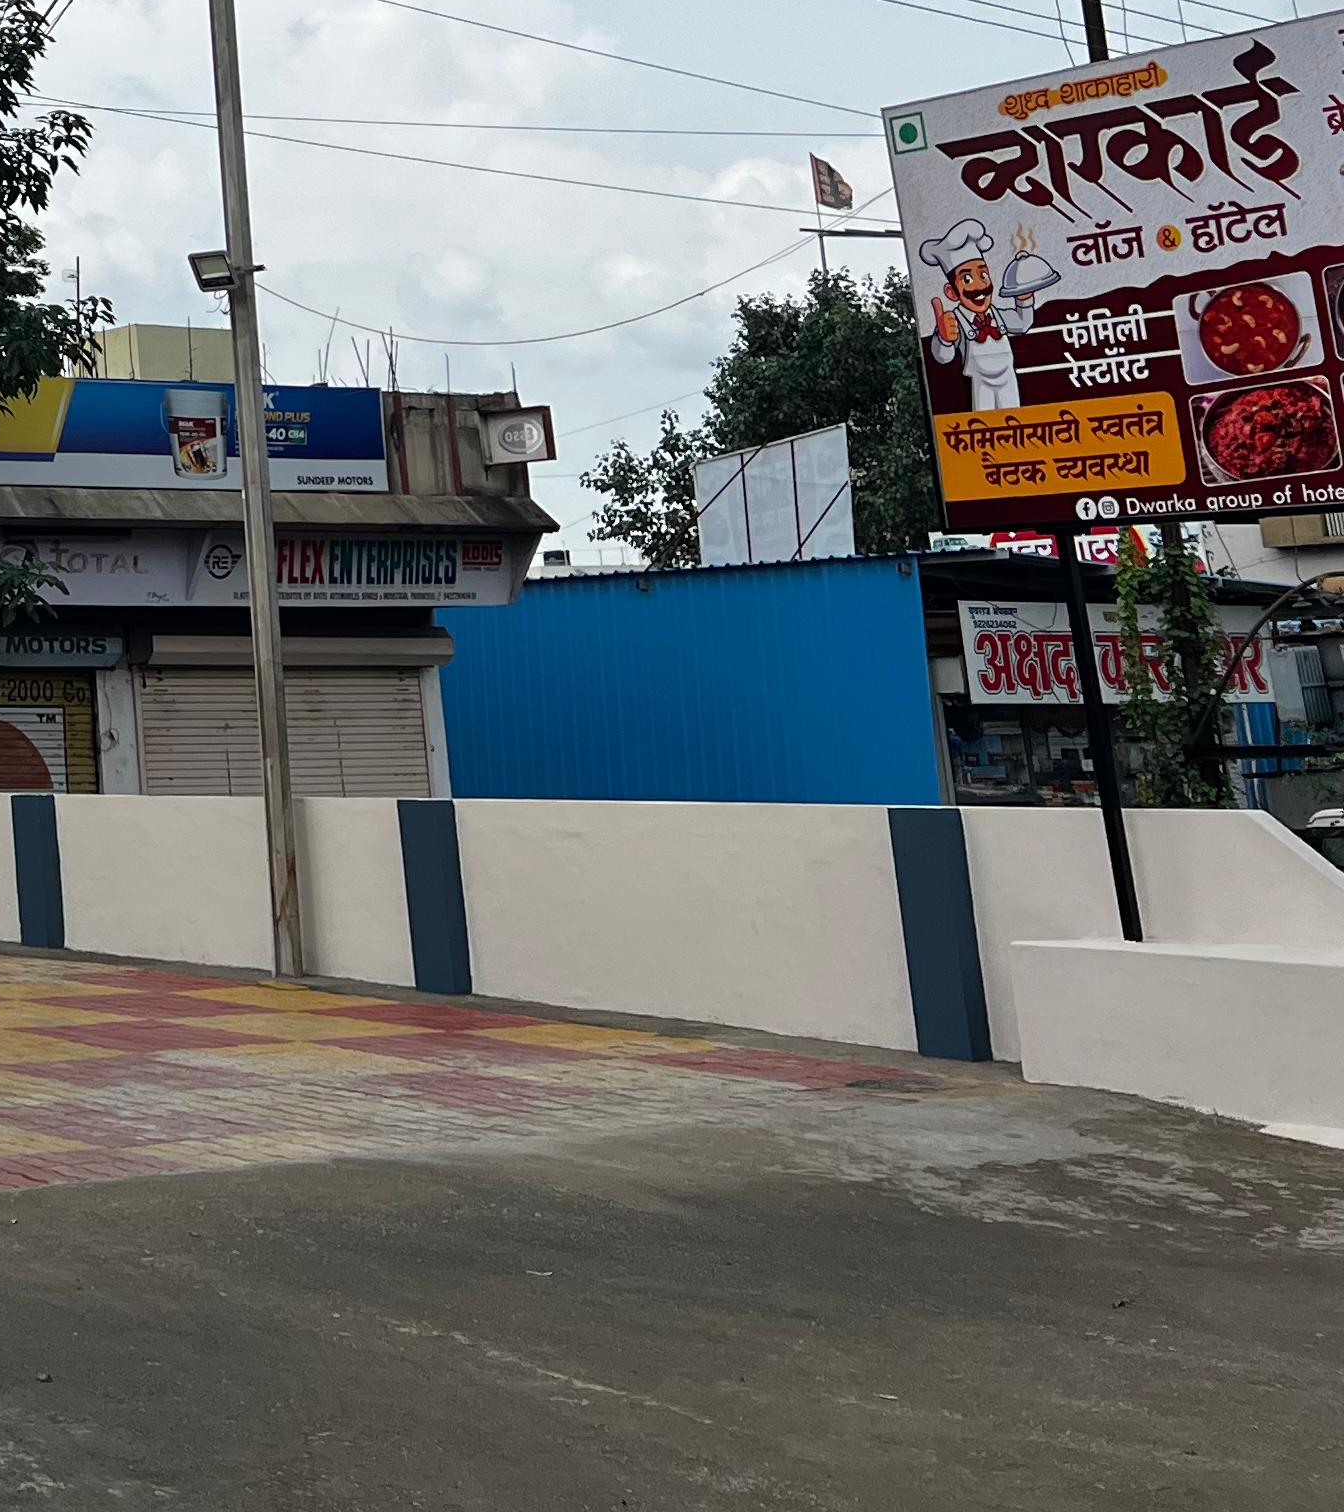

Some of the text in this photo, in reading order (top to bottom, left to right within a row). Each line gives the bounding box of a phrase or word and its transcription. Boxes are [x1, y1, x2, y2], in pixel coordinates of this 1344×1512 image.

[1060, 64, 1161, 104] शाकाहारी
[1067, 201, 1289, 266] लॉज & हॉटेल
[1062, 304, 1148, 348] फॅमिली
[284, 412, 311, 424] PLUS
[943, 404, 1164, 454] फॅमिलीसाठी स्वतंत्र
[297, 476, 374, 487] SUNDEEP MOTORS
[981, 450, 1150, 487] बैठक व्यवस्था
[1126, 494, 1197, 515] Dwarka
[1273, 484, 1292, 504] of
[329, 540, 457, 584] ENTERPRISES
[6, 636, 107, 654] MOTORS
[38, 713, 57, 724] TM
